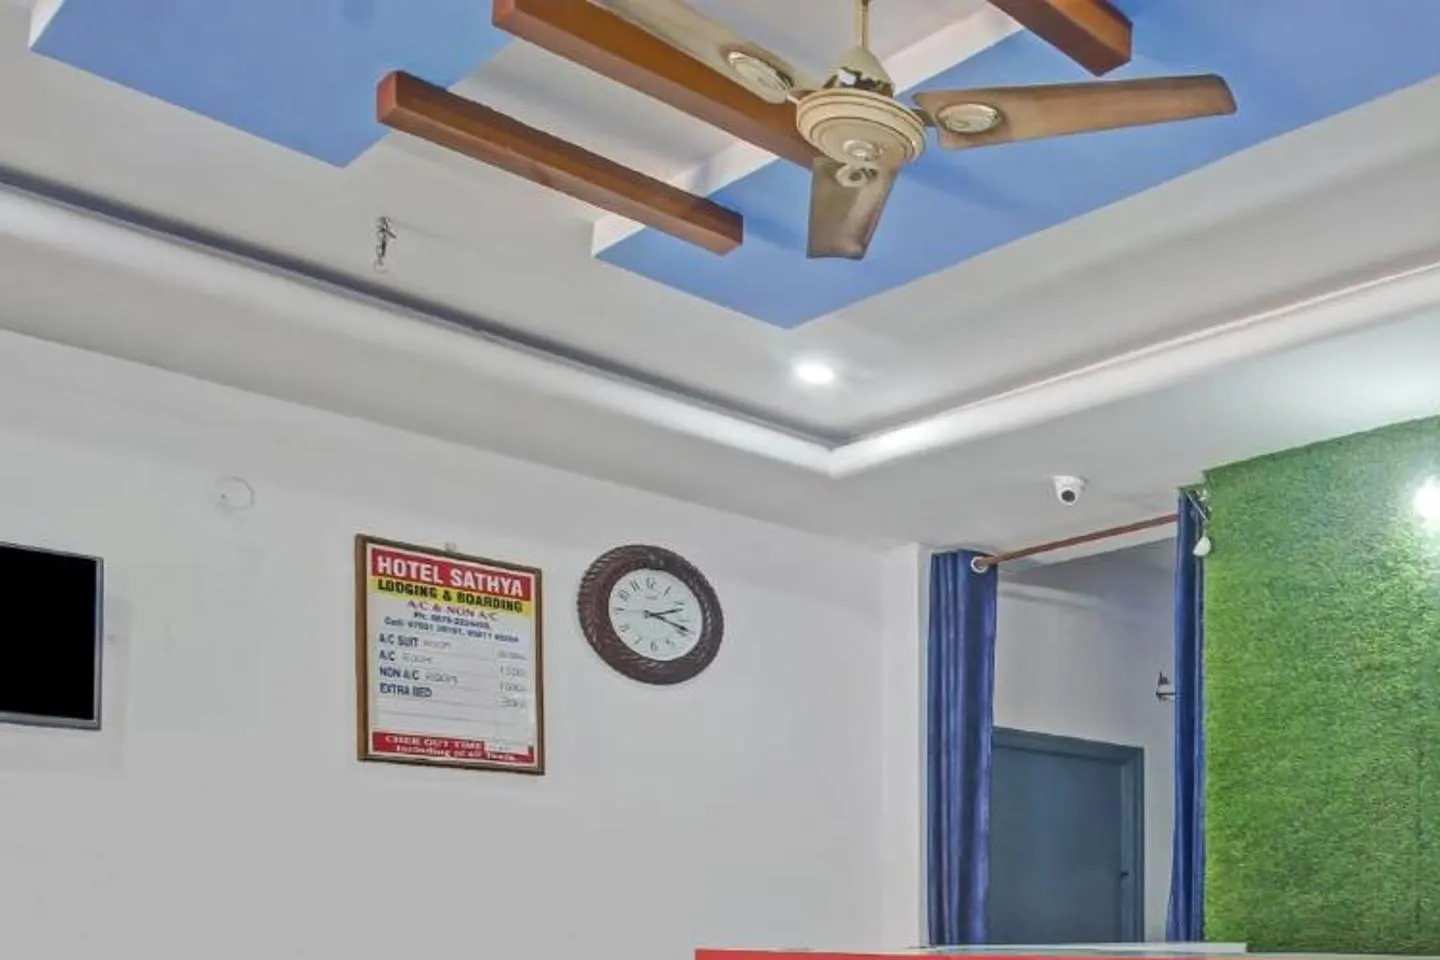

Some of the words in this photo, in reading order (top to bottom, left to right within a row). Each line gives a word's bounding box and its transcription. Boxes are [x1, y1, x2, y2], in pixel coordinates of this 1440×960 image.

[377, 555, 444, 584] HOTEL
[450, 568, 523, 597] SATHYA
[377, 579, 437, 599] LODGING
[442, 589, 453, 602] &
[456, 590, 523, 613] BOARDING
[379, 665, 401, 679] NON
[379, 682, 410, 697] EXTRA
[412, 685, 433, 699] BED
